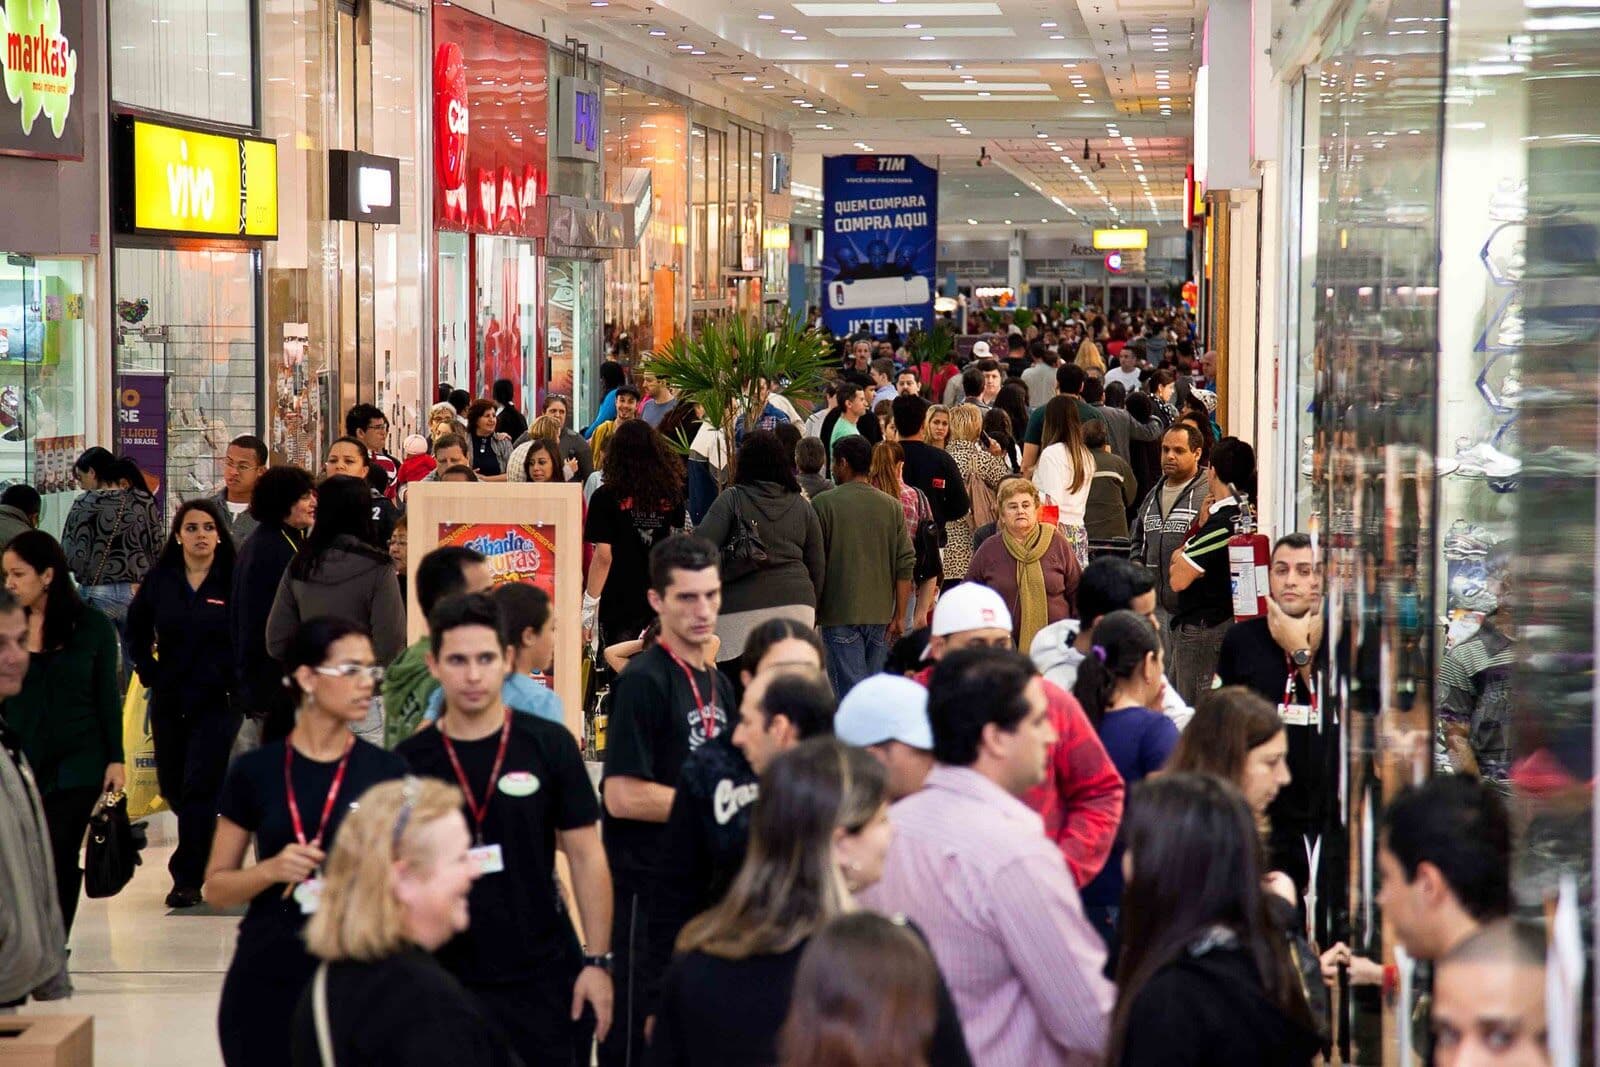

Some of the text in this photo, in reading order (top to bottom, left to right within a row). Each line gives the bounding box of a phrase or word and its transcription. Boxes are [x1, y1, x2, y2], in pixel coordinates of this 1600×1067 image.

[878, 157, 906, 171] TIM
[166, 138, 215, 221] vivo
[834, 195, 927, 216] QUEM COMPARA
[834, 212, 928, 233] COMPRA AQUI
[128, 428, 158, 438] LIGUE
[371, 506, 381, 520] 2
